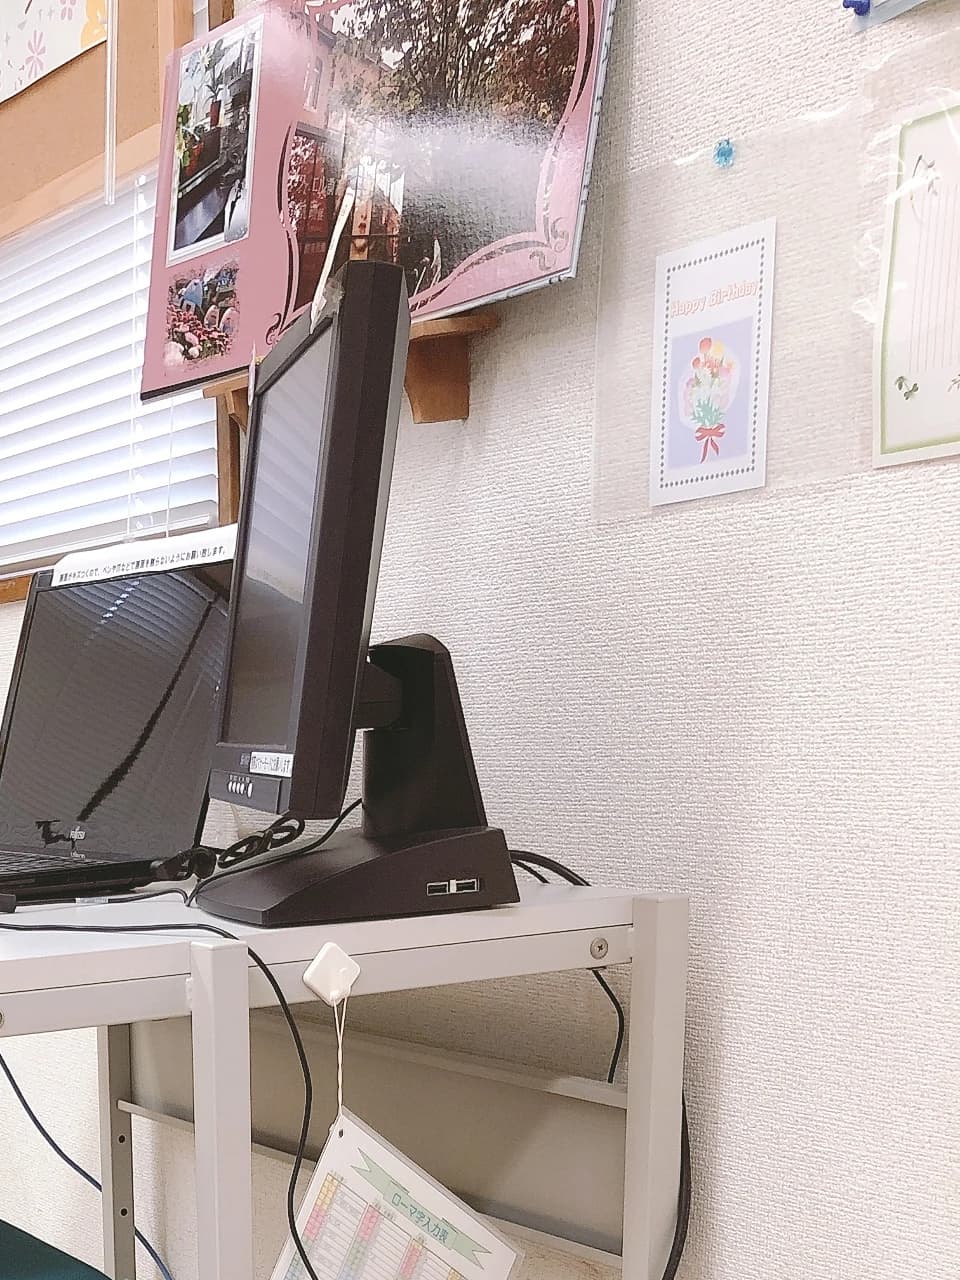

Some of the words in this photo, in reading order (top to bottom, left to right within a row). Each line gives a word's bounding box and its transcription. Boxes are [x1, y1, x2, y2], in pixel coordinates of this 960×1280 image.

[670, 296, 706, 317] Happy
[391, 1192, 449, 1243] ローマ字入力表
